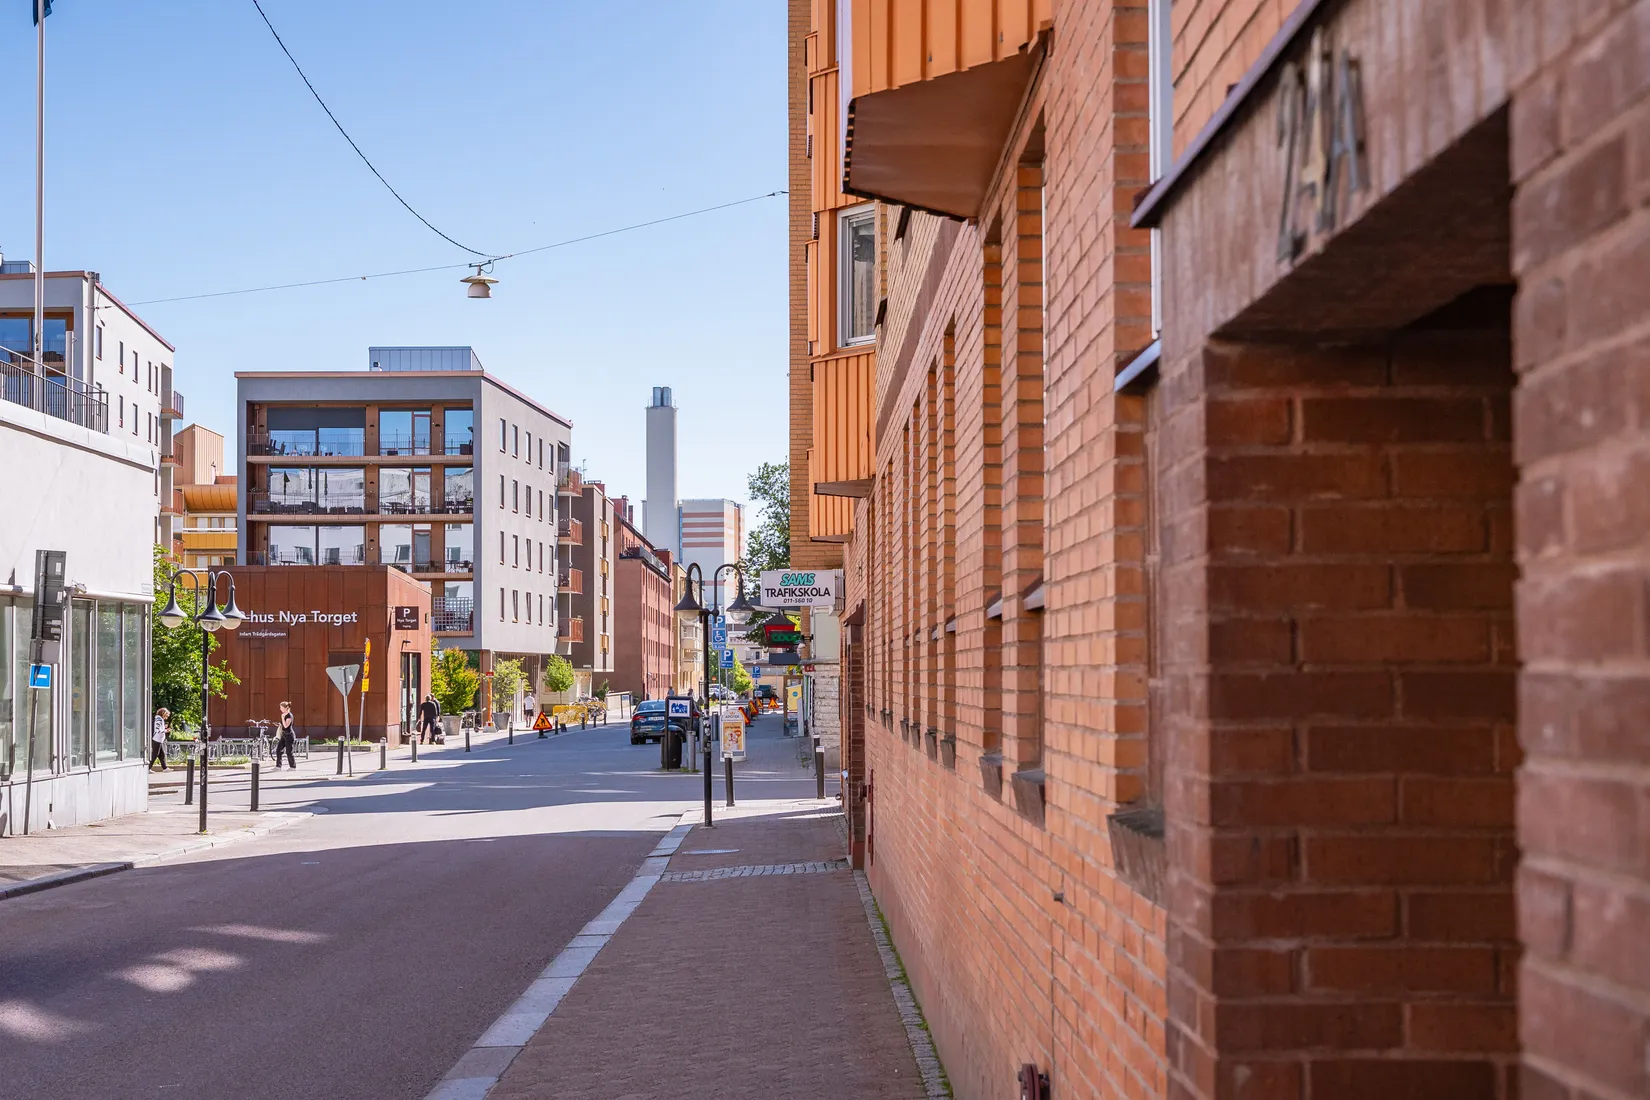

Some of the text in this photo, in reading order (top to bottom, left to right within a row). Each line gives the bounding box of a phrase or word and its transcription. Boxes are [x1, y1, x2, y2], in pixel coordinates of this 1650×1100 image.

[780, 573, 816, 586] SAMS
[765, 587, 831, 598] TRAFIKSKOLA
[279, 610, 306, 626] Nya
[310, 610, 358, 626] Torget
[403, 608, 411, 617] P
[723, 650, 732, 661] P
